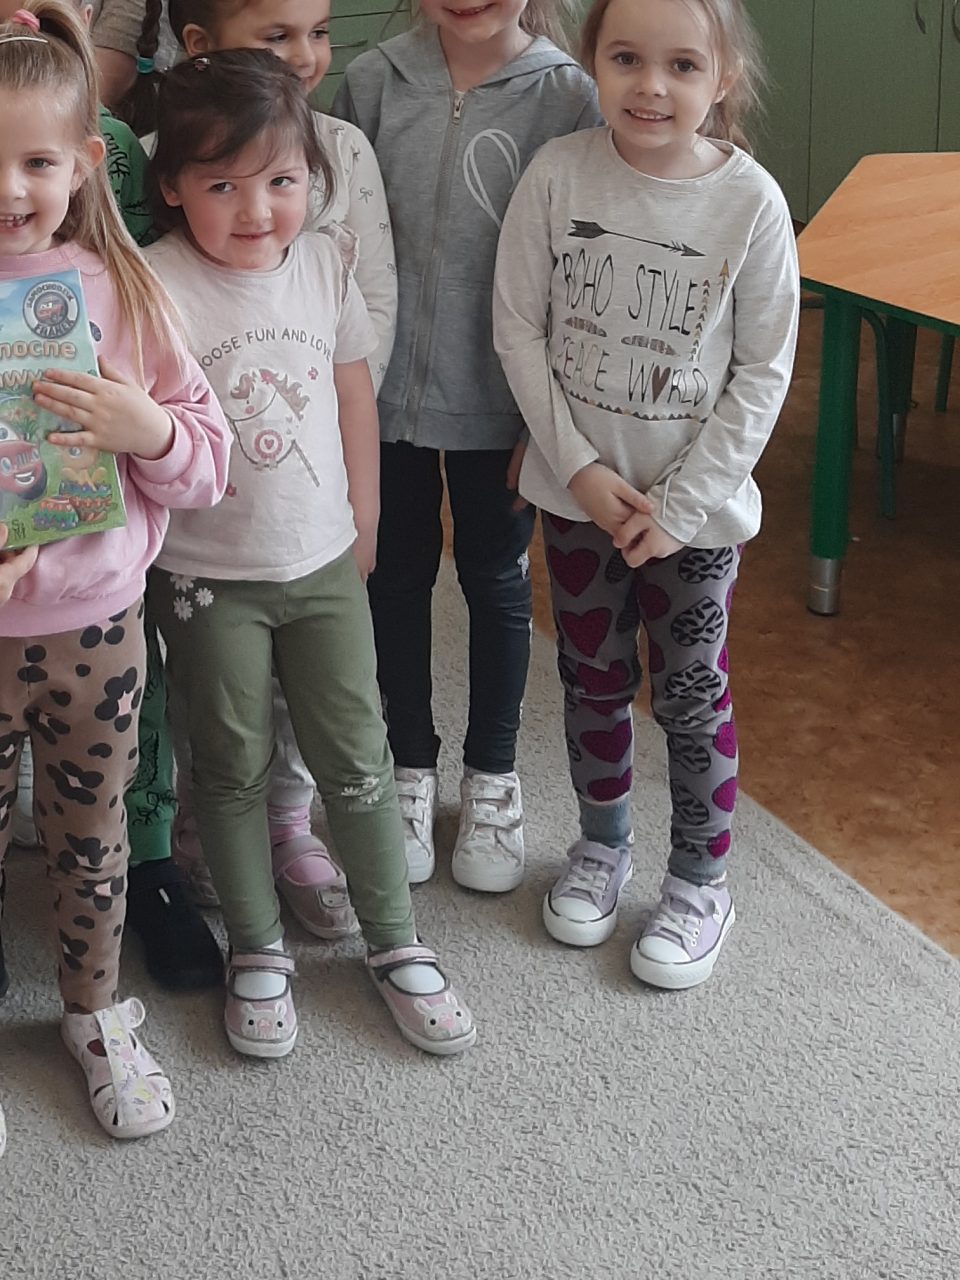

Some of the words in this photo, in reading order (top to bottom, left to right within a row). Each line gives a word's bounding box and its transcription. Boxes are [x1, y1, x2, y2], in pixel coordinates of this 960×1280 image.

[561, 248, 614, 317] BOHO
[628, 263, 698, 336] STYLE
[200, 336, 242, 370] OOSE
[245, 327, 276, 345] FUN
[281, 327, 307, 344] AND
[310, 334, 332, 363] LOVE
